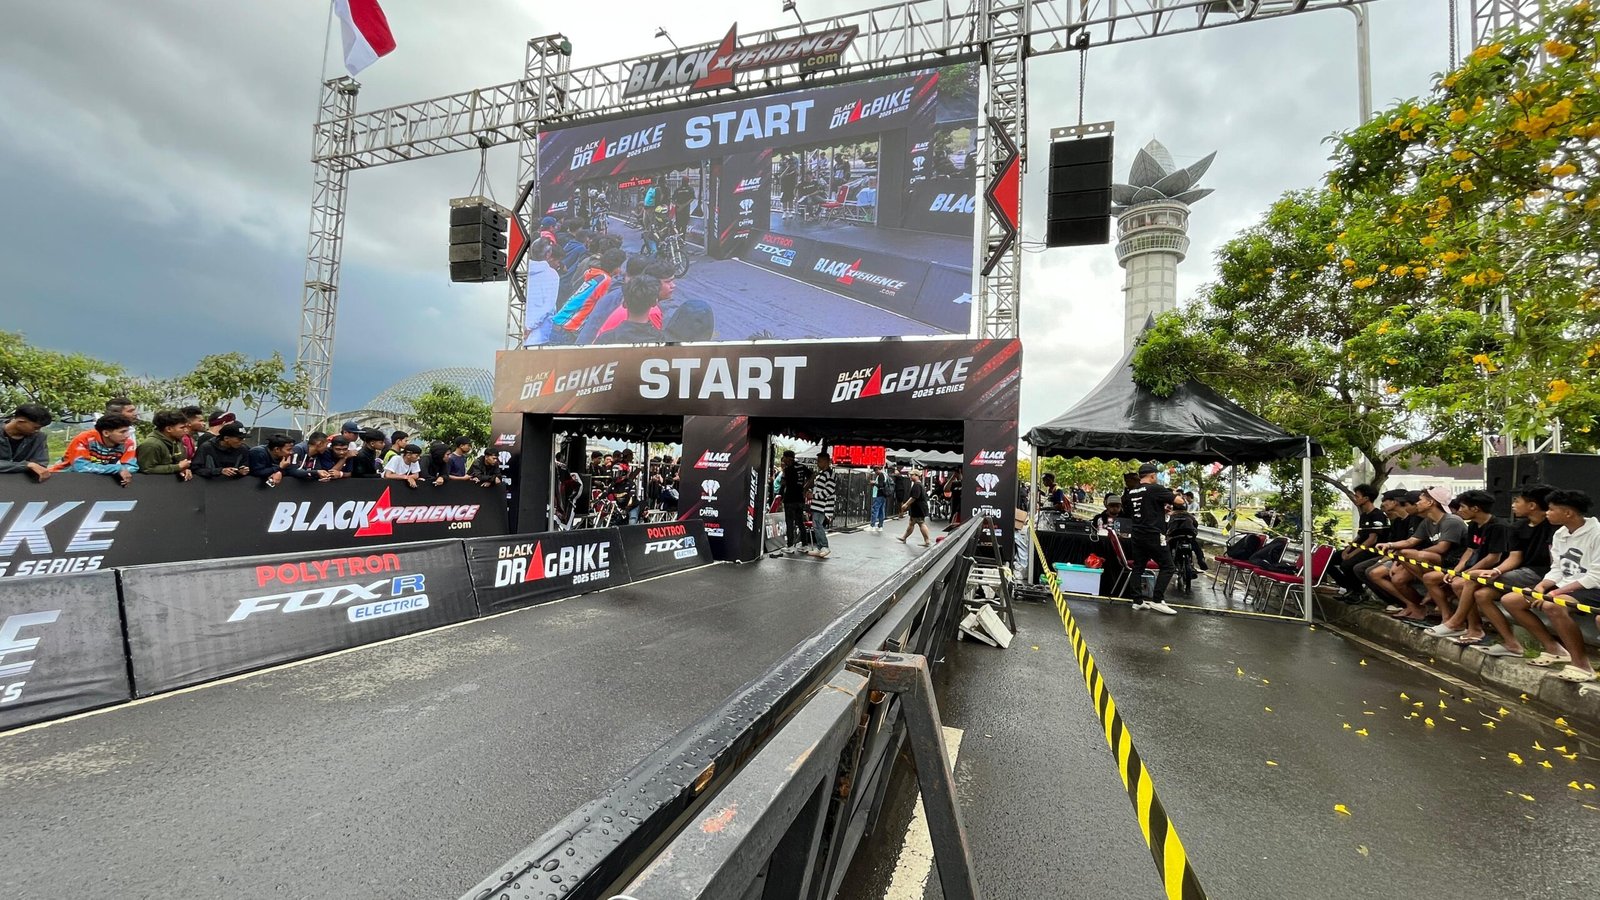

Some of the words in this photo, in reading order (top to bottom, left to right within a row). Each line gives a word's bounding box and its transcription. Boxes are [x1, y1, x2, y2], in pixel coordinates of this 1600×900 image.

[802, 51, 838, 68] .com
[834, 101, 857, 115] BLACK
[878, 107, 892, 119] 2025
[892, 103, 909, 115] SERIES
[685, 99, 815, 149] START
[574, 140, 600, 155] BLACK
[626, 149, 641, 158] 2025
[642, 141, 661, 153] SERIES
[740, 177, 761, 187] BLACK
[879, 289, 896, 297] .com
[525, 371, 550, 382] BLACK
[639, 355, 808, 400] START
[837, 367, 874, 383] BLACK
[575, 387, 591, 397] 2025
[592, 384, 613, 395] SERIES
[911, 388, 933, 399] 2025
[935, 383, 965, 394] SERIES
[704, 452, 731, 462] BLACK
[979, 450, 1007, 459] BLACK
[448, 521, 472, 530] .com
[647, 525, 686, 539] POLYTRON
[498, 543, 534, 559] BLACK
[14, 555, 105, 577] SERIES
[255, 553, 400, 588] POLYTRON
[573, 574, 589, 585] 2025
[590, 569, 610, 581] SERIES
[354, 597, 424, 619] ELECTRIC
